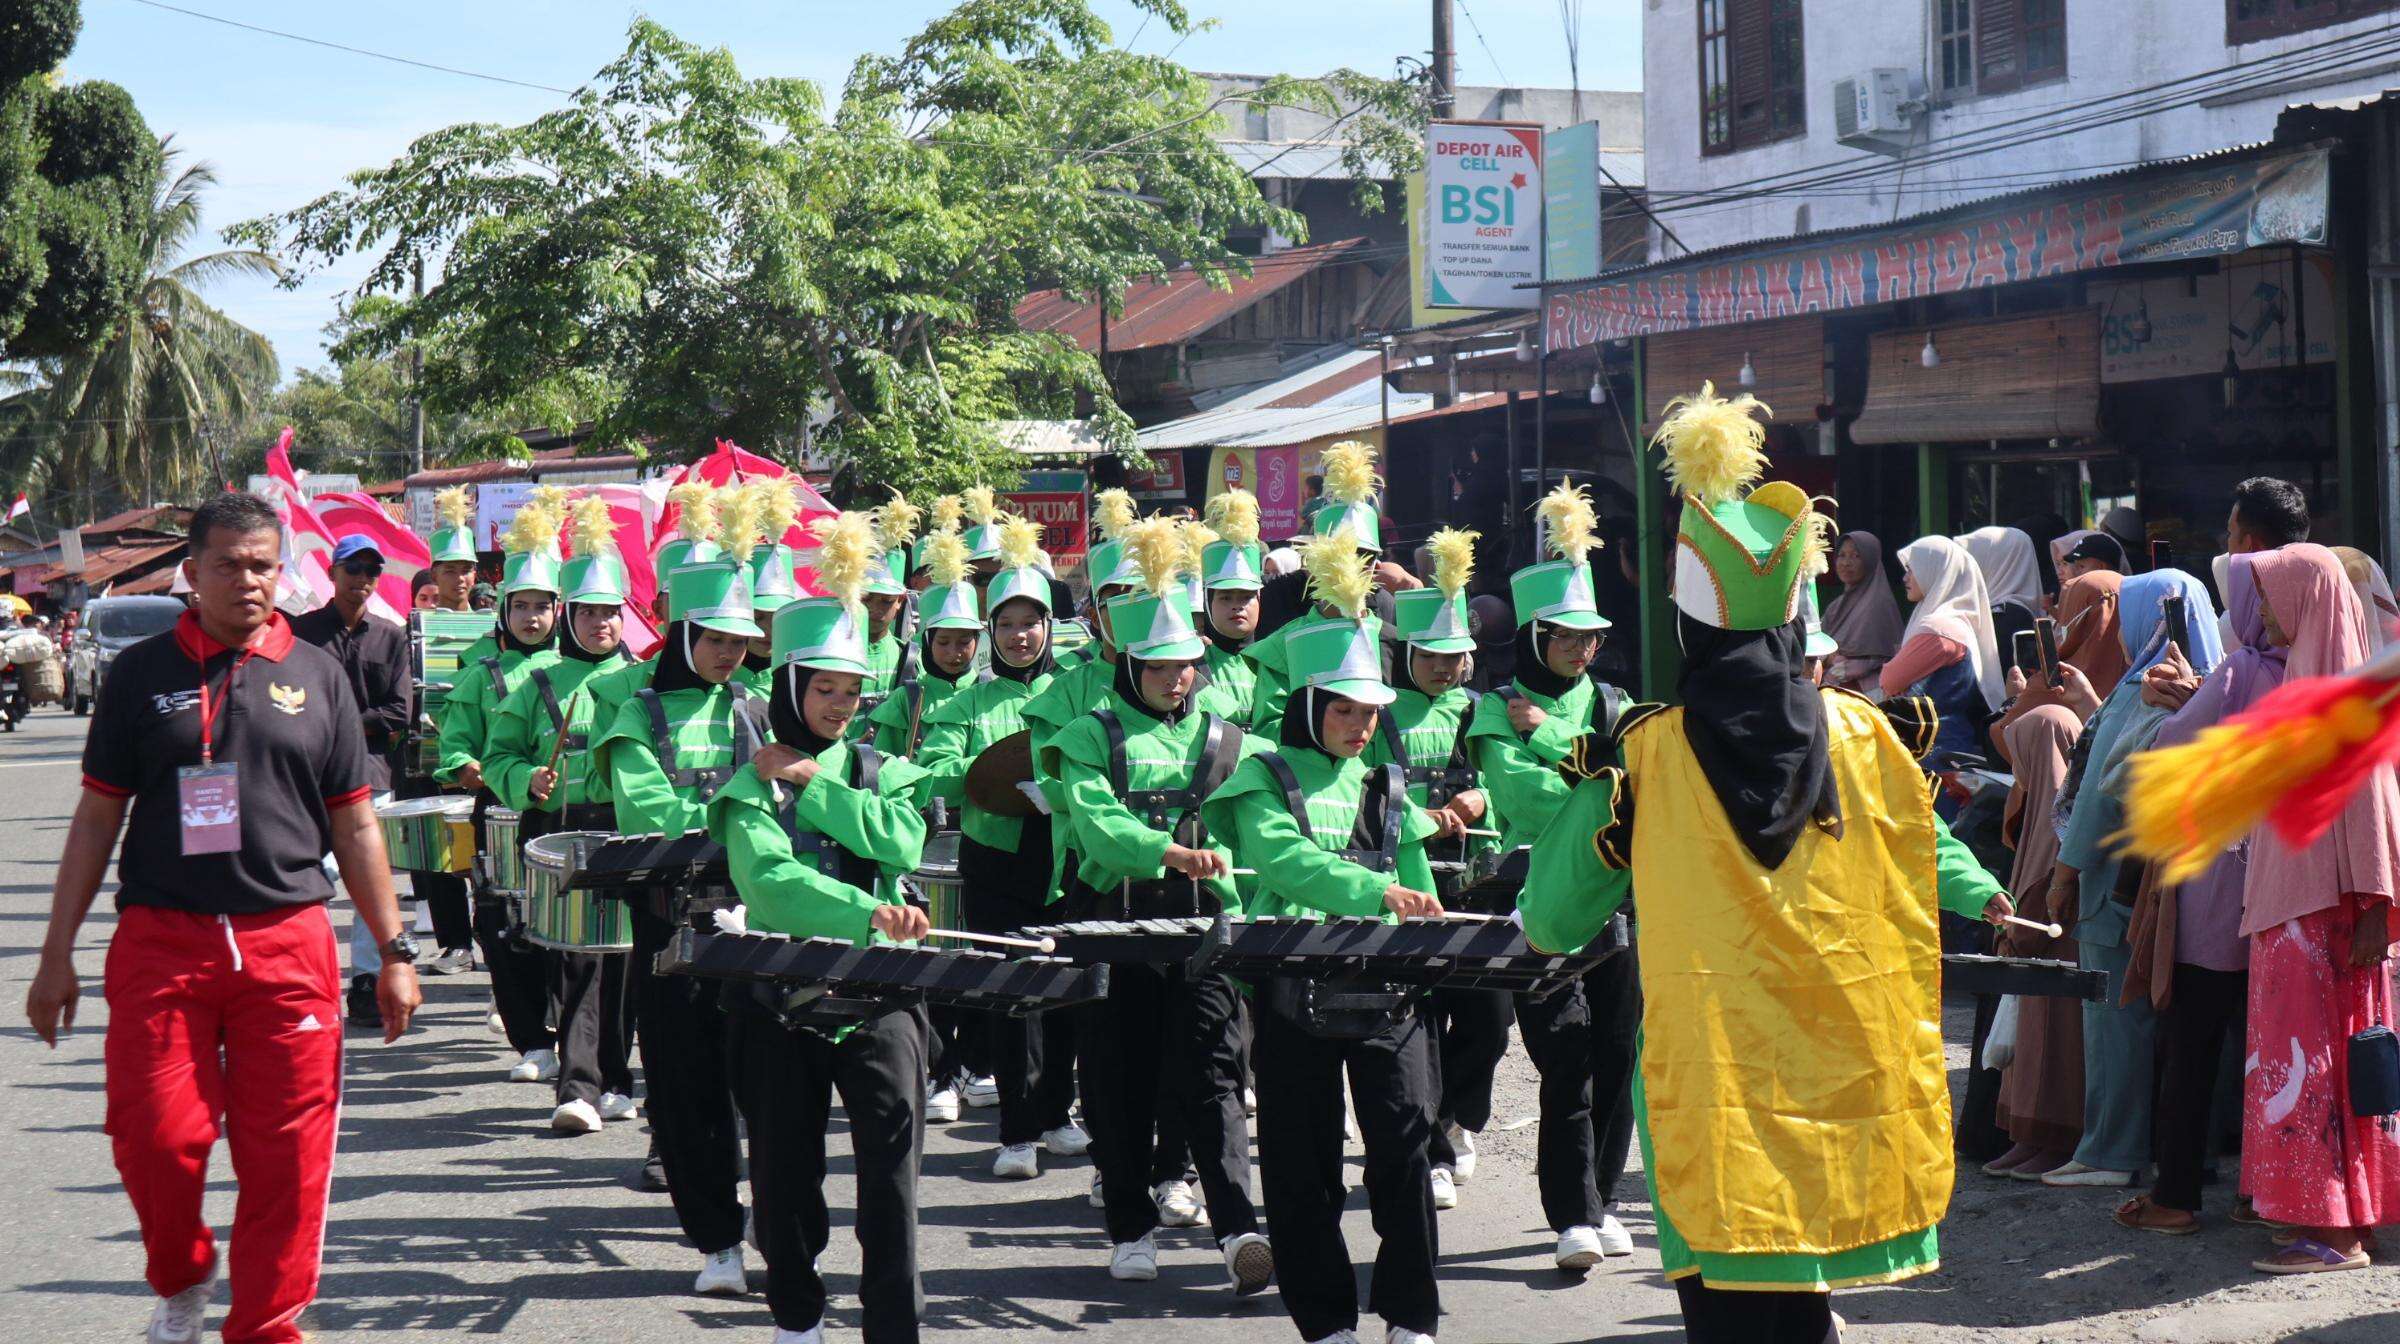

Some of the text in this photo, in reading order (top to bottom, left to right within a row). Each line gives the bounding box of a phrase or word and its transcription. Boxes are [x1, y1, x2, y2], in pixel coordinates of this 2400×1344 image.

[1860, 85, 1868, 121] AUX
[1436, 142, 1523, 157] DEPOT AIR
[1460, 157, 1500, 171] CELL
[1441, 184, 1514, 225] BSI
[1475, 227, 1513, 238] AGENT
[1505, 271, 1532, 279] LISTRIK
[1547, 195, 2126, 353] RUMAH MAKAN HIDAYAH
